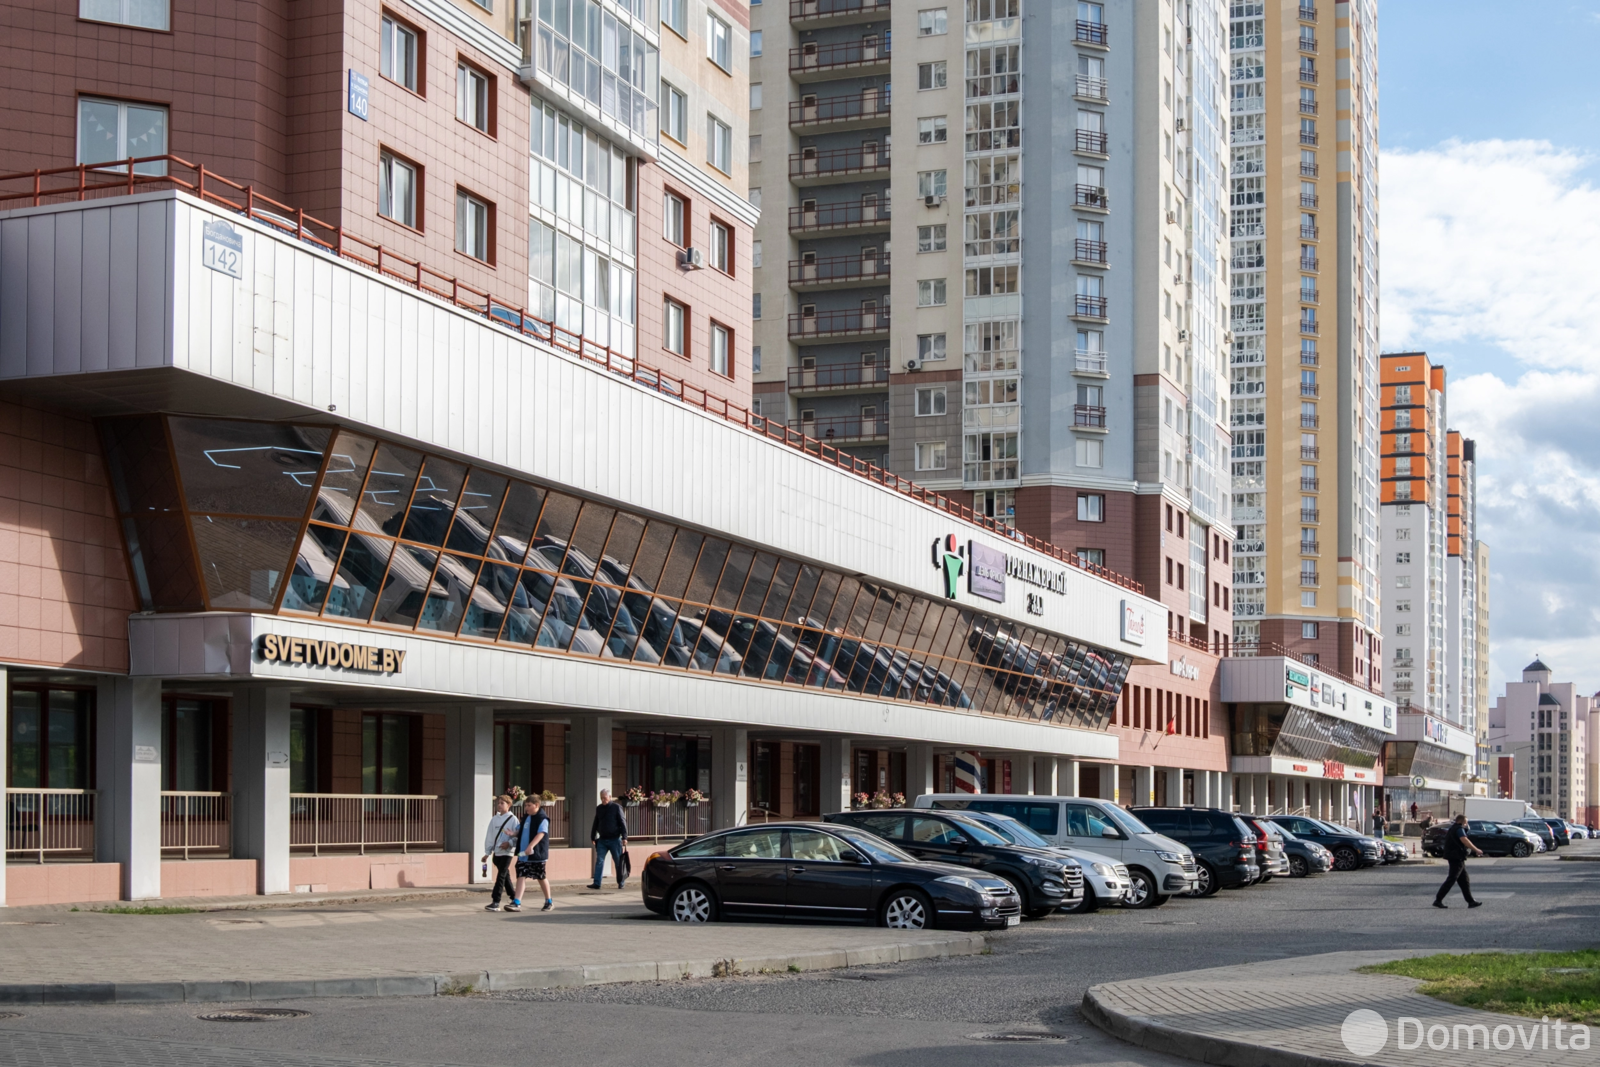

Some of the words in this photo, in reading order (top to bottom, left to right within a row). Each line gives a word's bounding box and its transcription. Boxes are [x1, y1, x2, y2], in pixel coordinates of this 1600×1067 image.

[351, 92, 368, 116] 140
[205, 226, 242, 248] Богдановича
[209, 244, 238, 273] 142
[263, 634, 406, 674] SVETVDOME.BY
